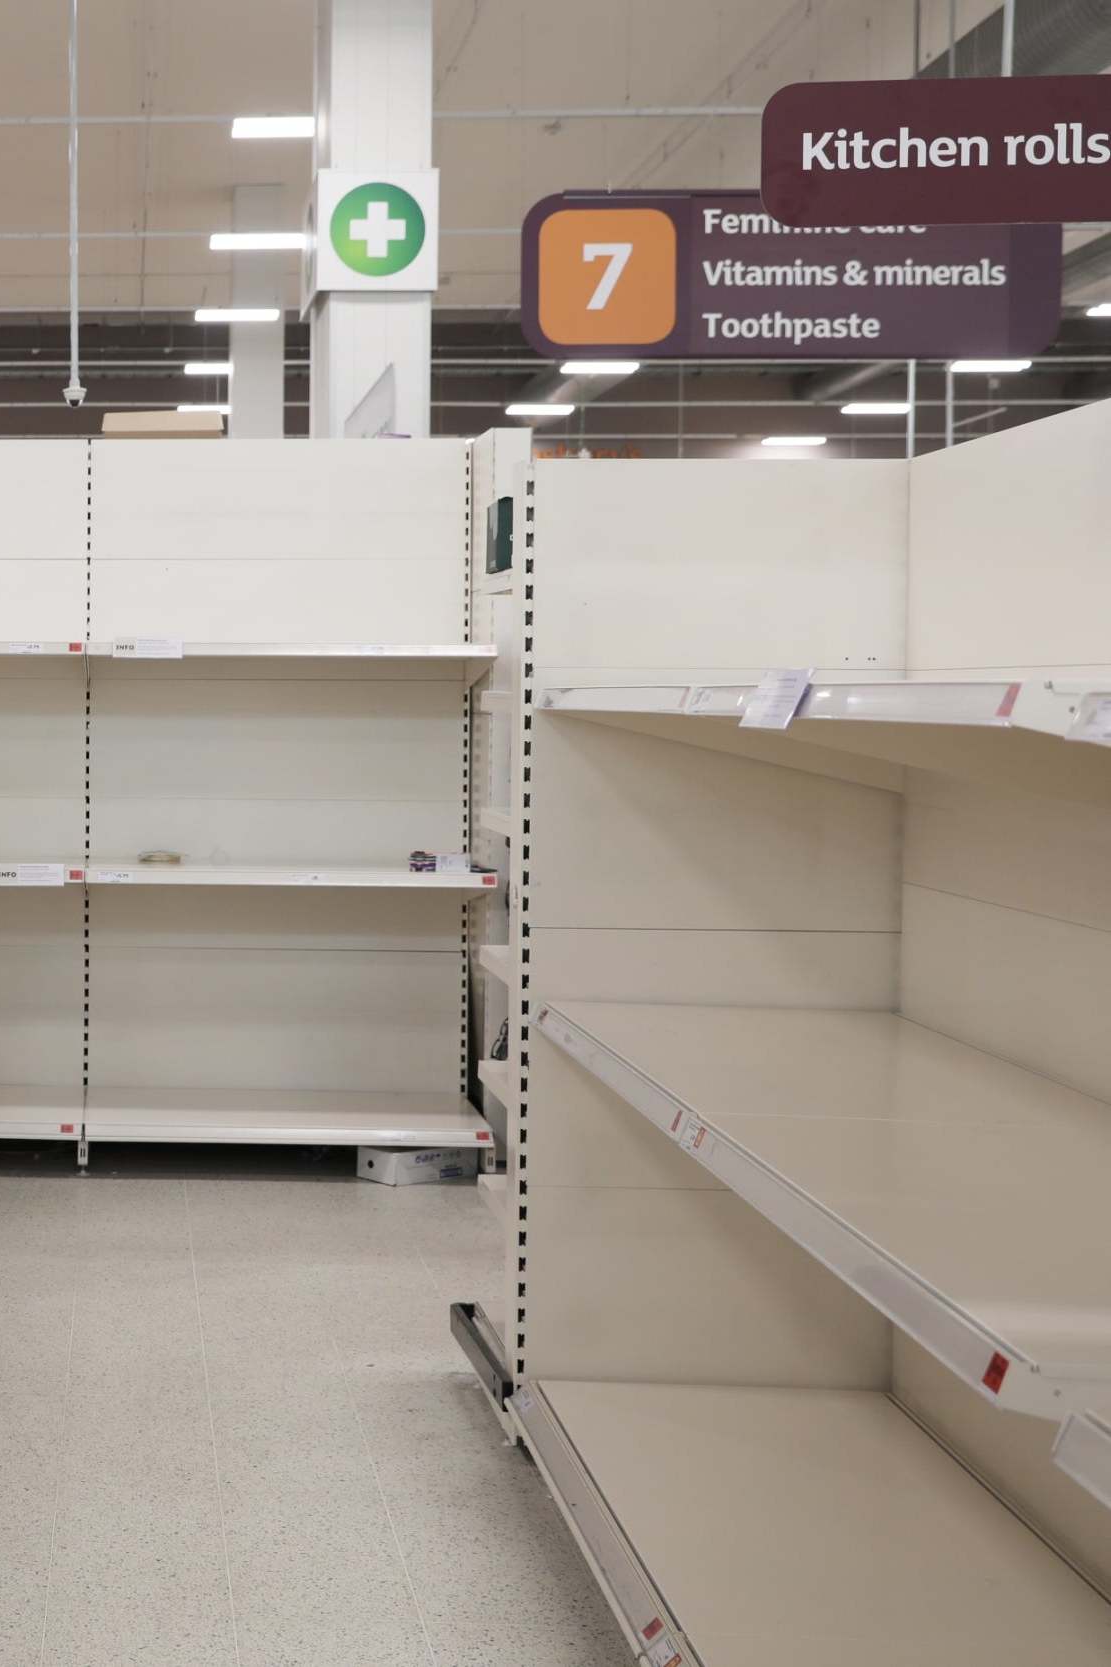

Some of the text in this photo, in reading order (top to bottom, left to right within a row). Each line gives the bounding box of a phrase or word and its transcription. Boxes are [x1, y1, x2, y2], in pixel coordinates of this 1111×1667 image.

[802, 122, 1111, 170] Kitchen rolls
[582, 243, 633, 310] 7
[702, 258, 1007, 286] Vitamins & minerals
[701, 311, 881, 345] Toothpaste
